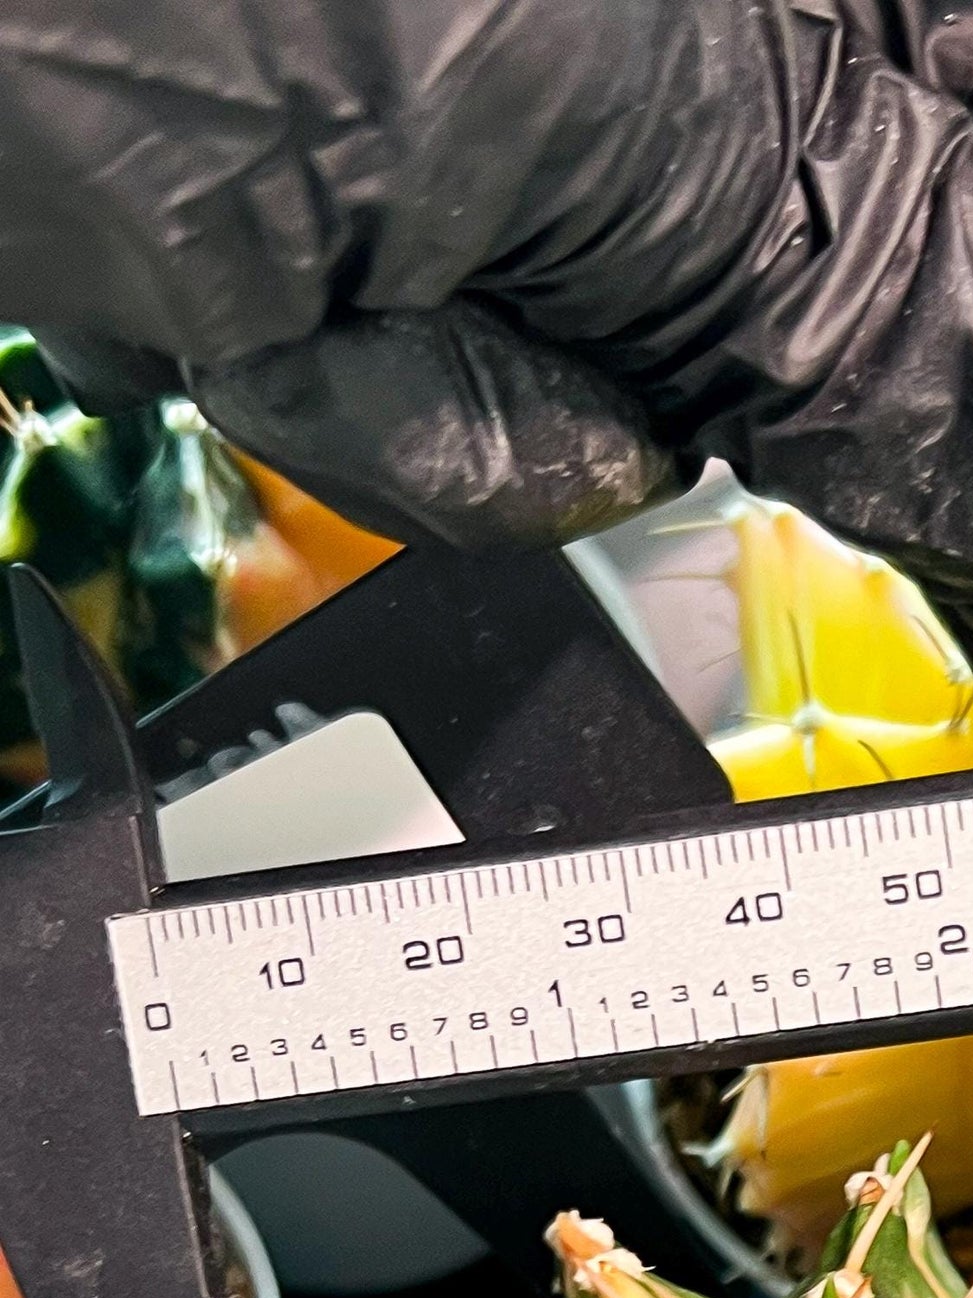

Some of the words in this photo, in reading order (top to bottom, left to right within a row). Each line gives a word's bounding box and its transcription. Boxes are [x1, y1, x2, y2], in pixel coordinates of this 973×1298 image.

[143, 1002, 172, 1032] 0
[258, 957, 306, 990] 10
[401, 935, 465, 971] 20
[562, 913, 626, 949] 30
[724, 891, 784, 927] 40
[881, 869, 944, 906] 50
[199, 1049, 210, 1066] 1
[230, 1043, 251, 1063] 2
[269, 1038, 289, 1057] 3
[310, 1033, 328, 1051] 4
[349, 1027, 367, 1047] 5
[389, 1022, 408, 1042] 6
[432, 1016, 448, 1036] 7
[468, 1011, 490, 1031] 8
[509, 1006, 529, 1027] 9
[547, 979, 563, 1008] 1
[598, 996, 609, 1013] 1
[630, 990, 650, 1010] 2
[671, 984, 690, 1003] 3
[712, 979, 729, 997] 4
[751, 973, 770, 993] 5
[791, 968, 811, 988] 6
[835, 962, 852, 982] 7
[872, 956, 894, 977] 8
[914, 951, 934, 972] 9
[937, 924, 970, 956] 2
